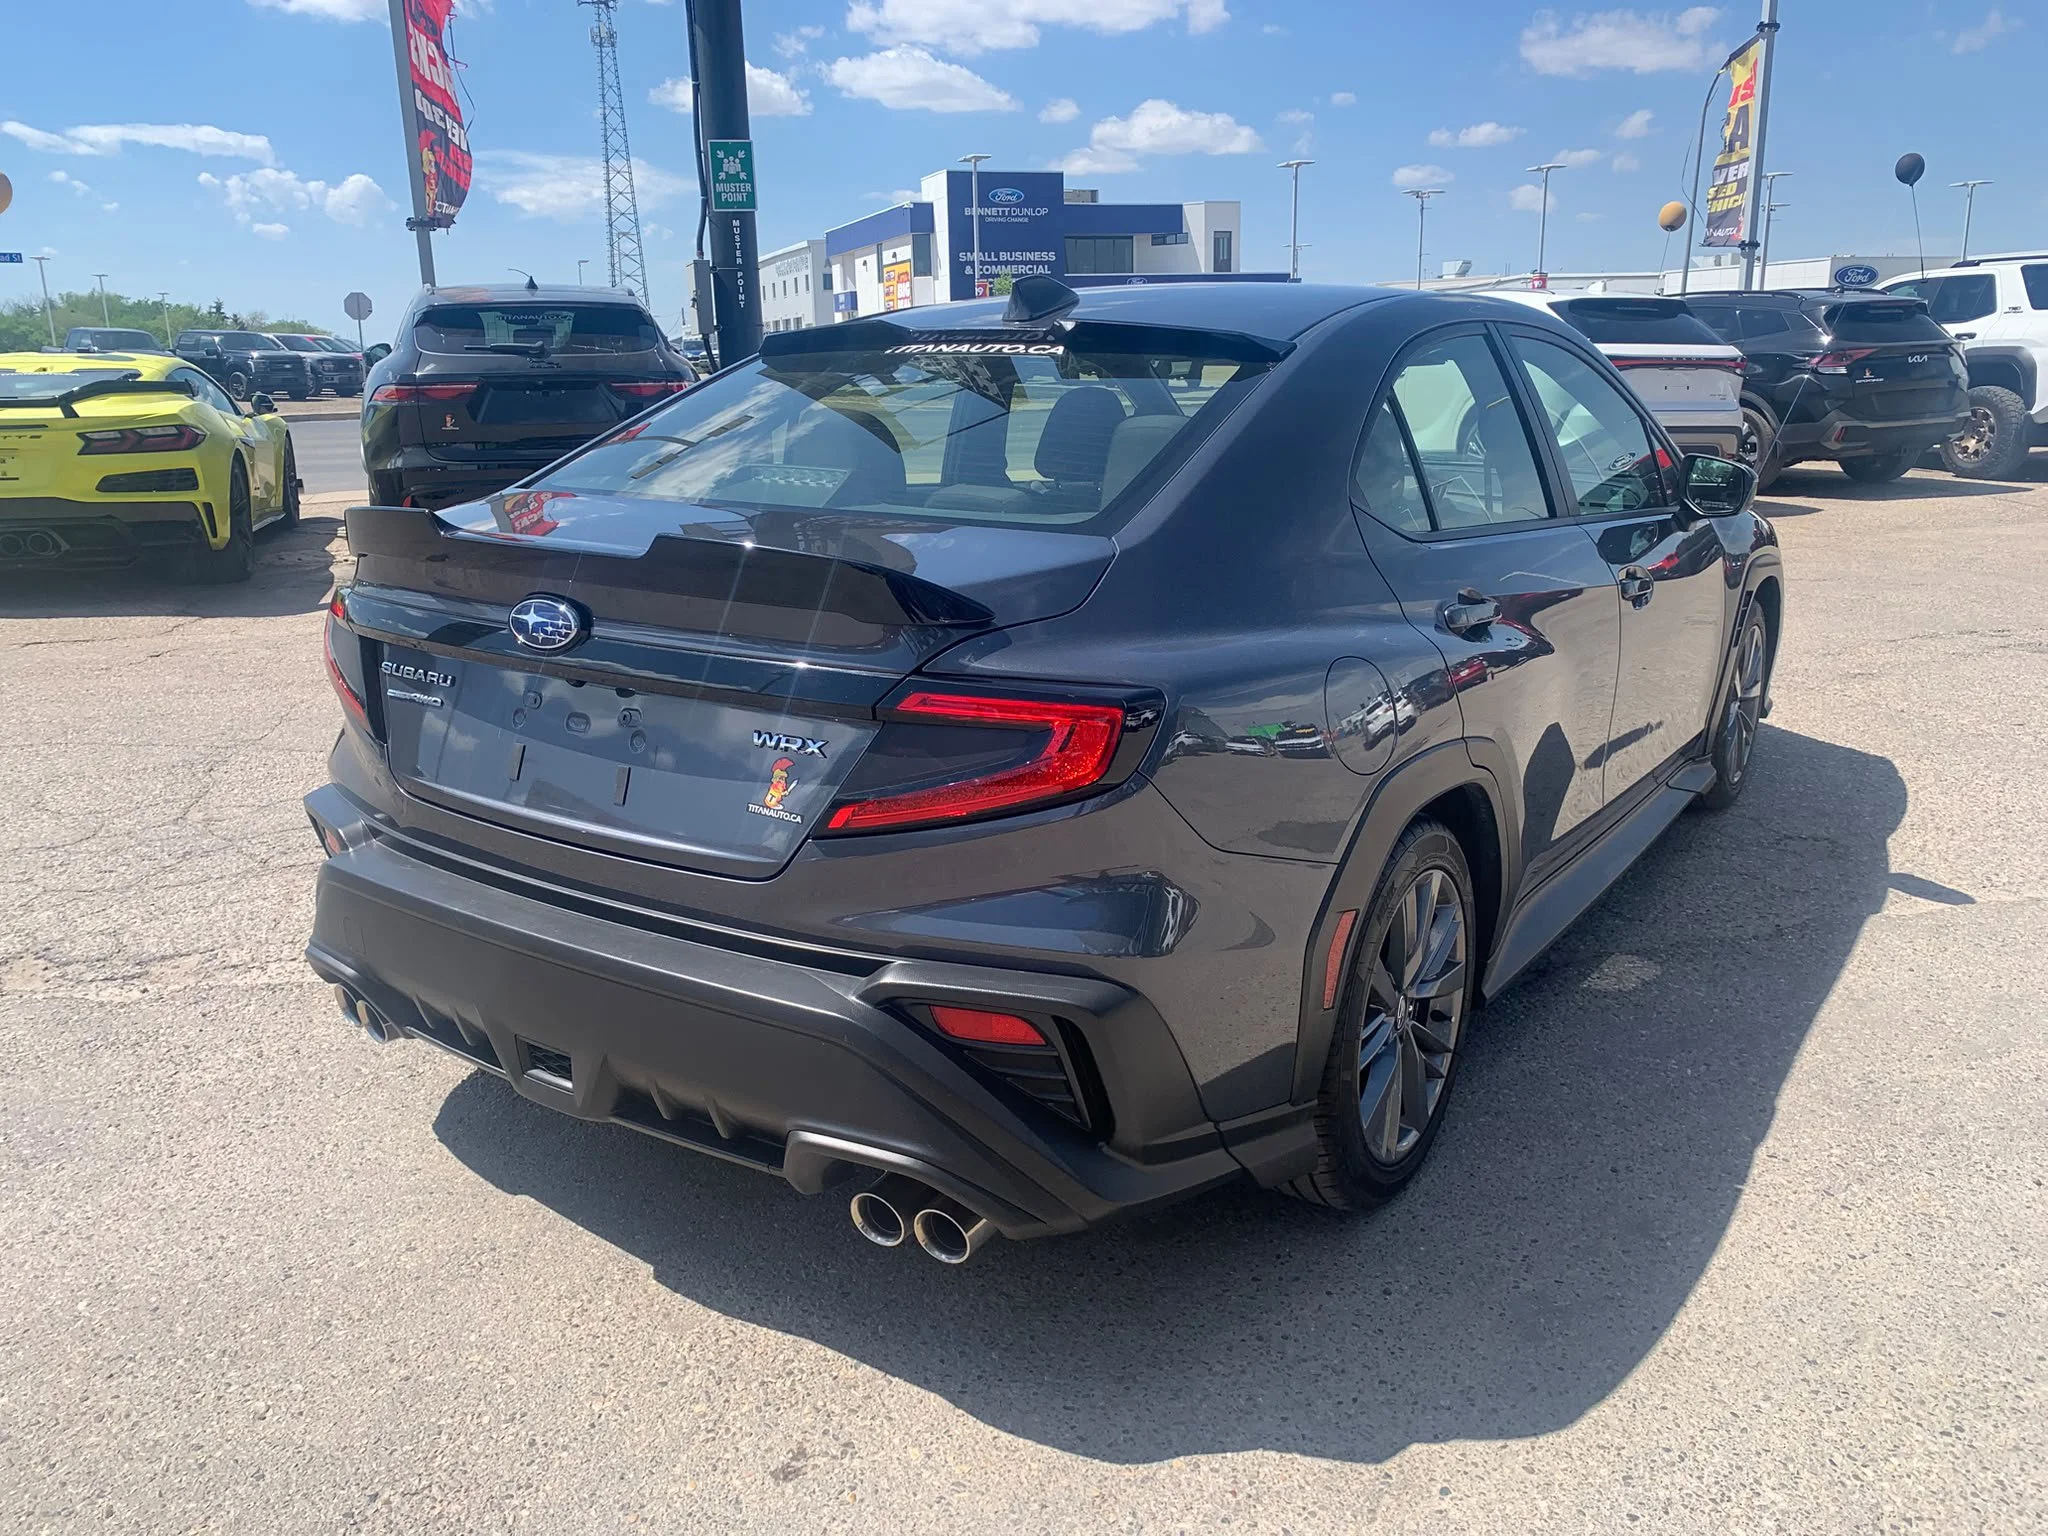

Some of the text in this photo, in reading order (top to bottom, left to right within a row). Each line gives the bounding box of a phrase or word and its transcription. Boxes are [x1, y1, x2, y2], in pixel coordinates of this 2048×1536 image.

[716, 183, 752, 193] MUSTER
[721, 193, 748, 202] POINT
[995, 190, 1018, 201] Ford
[1011, 207, 1049, 216] DUNLOP
[959, 251, 1056, 262] SMALL BUSINESS
[732, 219, 745, 308] MUSTER POINT
[964, 265, 974, 275] &
[1845, 269, 1871, 284] Ford
[884, 344, 1065, 355] TITANAUTO.CA
[381, 661, 453, 688] SUBARU
[752, 730, 829, 759] WRX
[747, 803, 802, 824] TITANAUTO.CA
